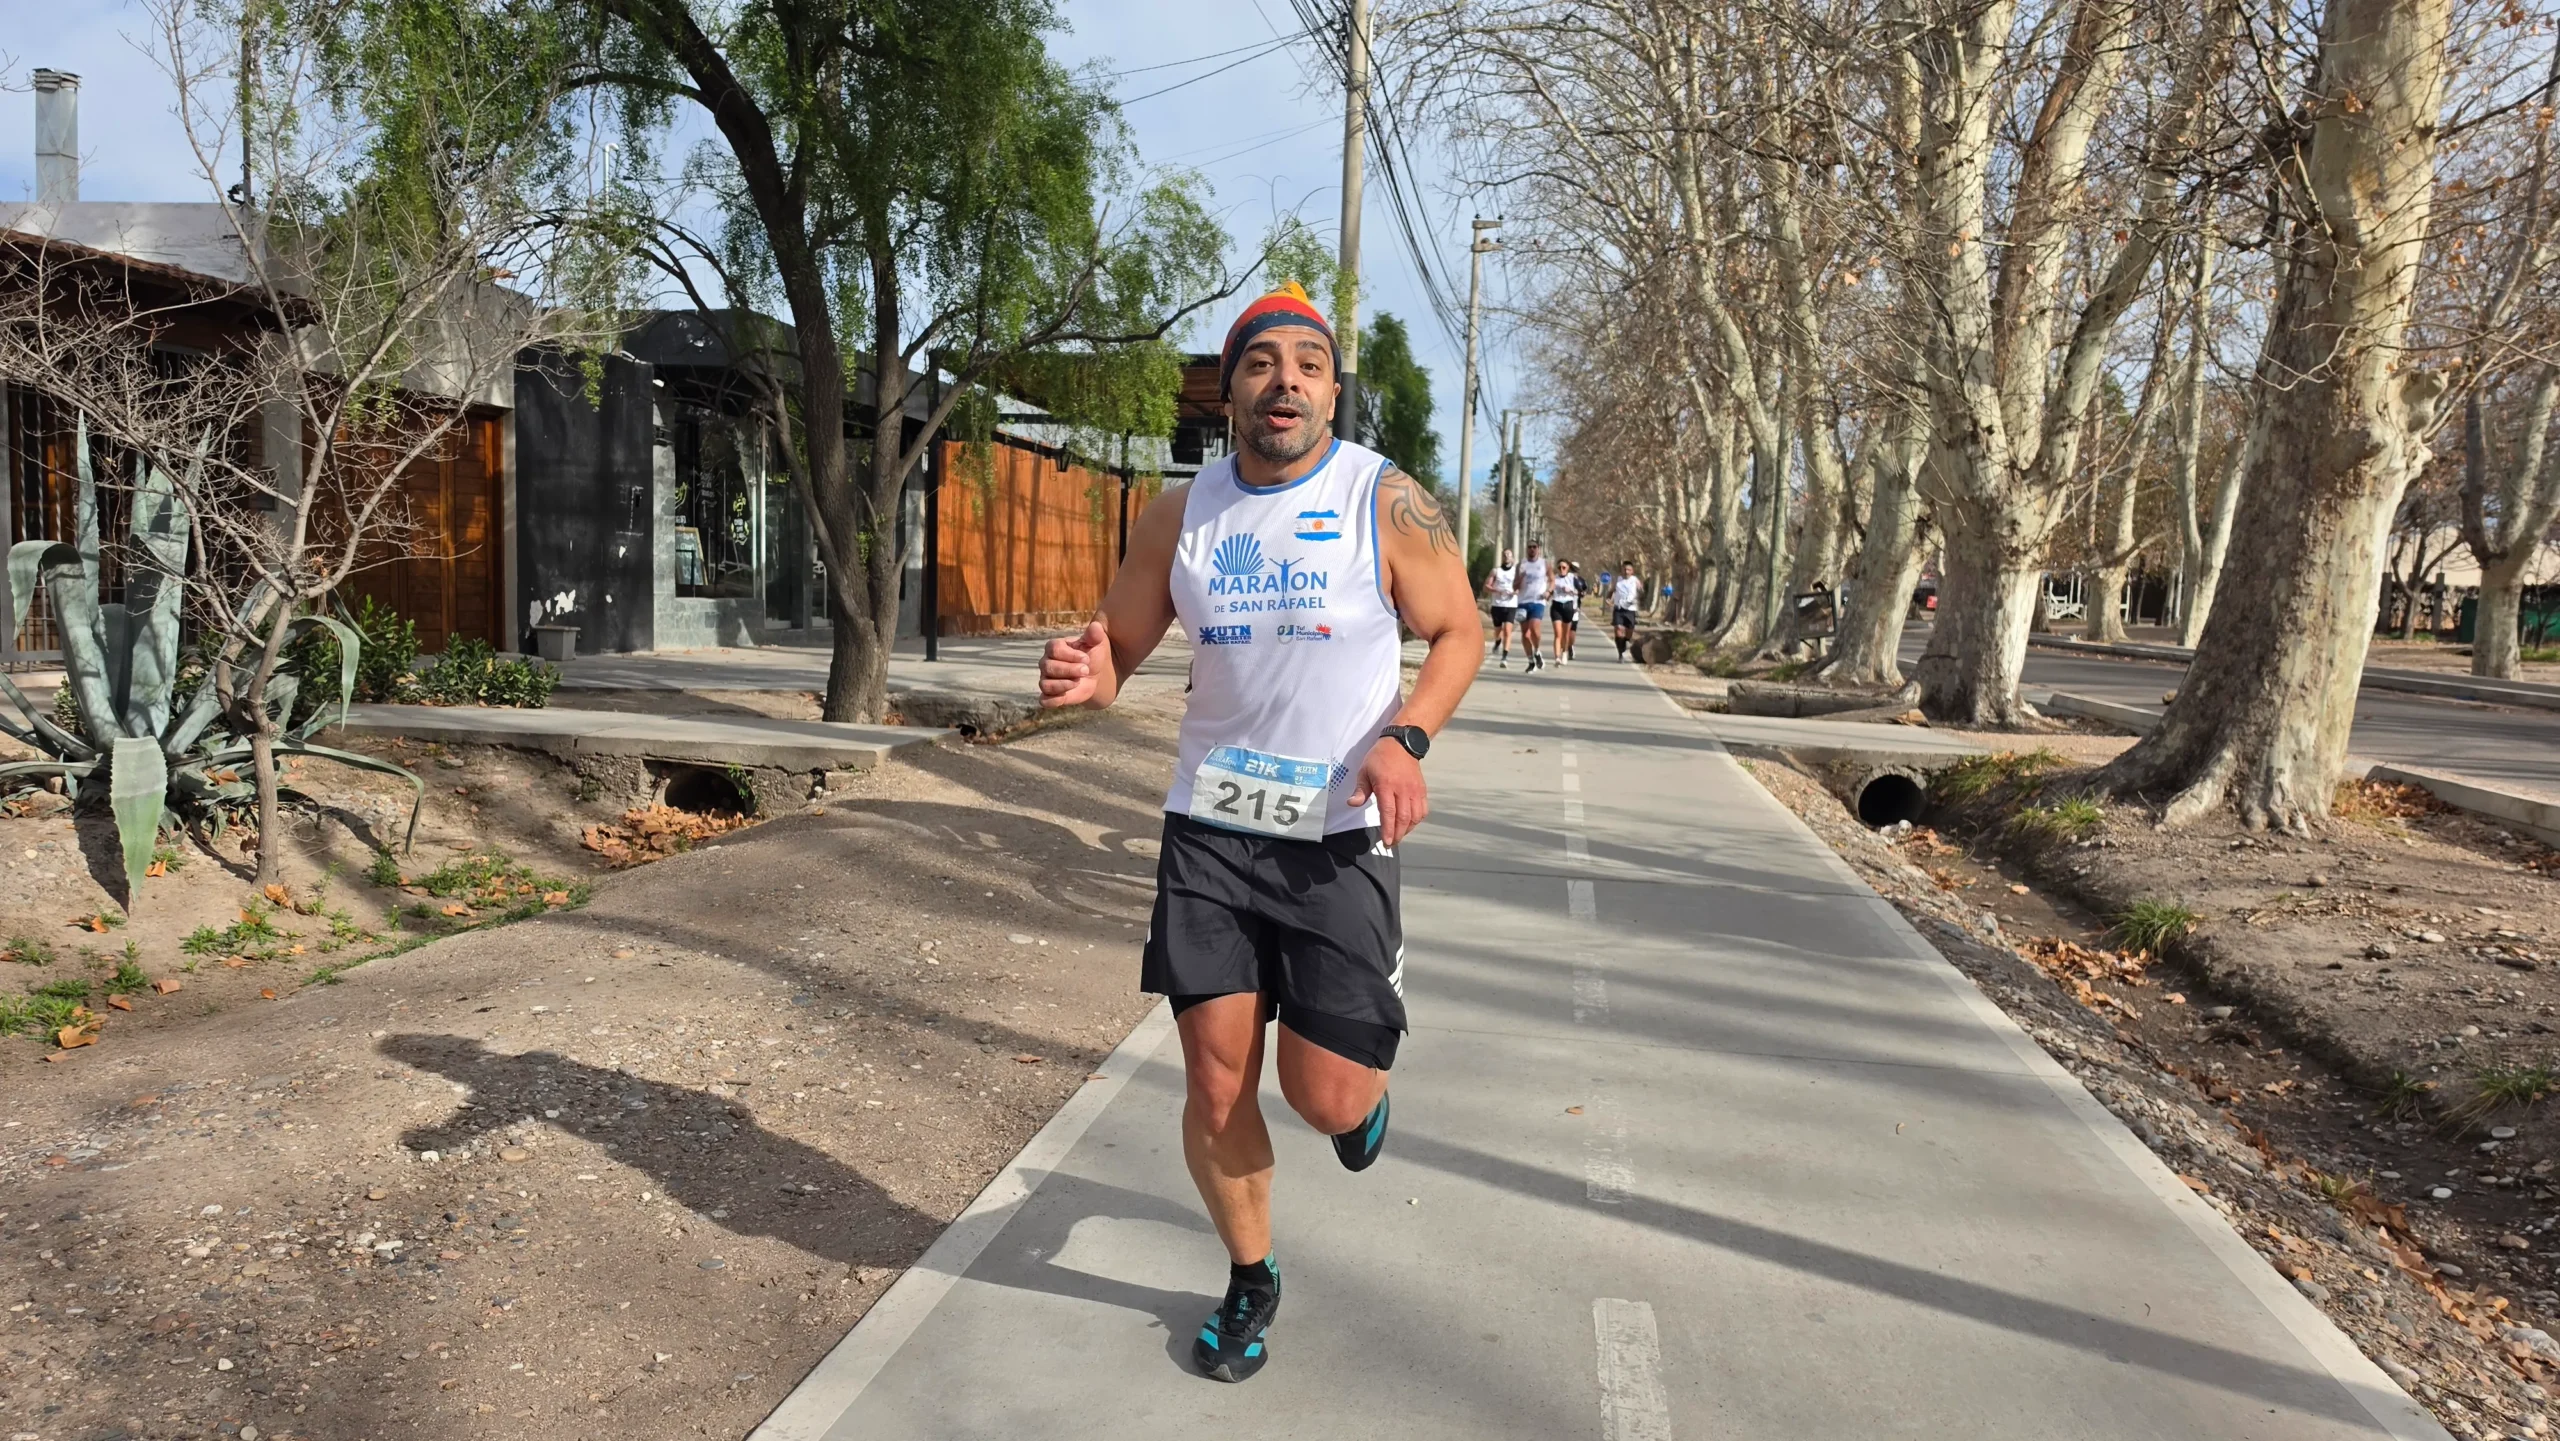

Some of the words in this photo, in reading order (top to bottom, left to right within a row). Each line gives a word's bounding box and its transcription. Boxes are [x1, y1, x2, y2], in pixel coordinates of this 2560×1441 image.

[1214, 604, 1225, 613] DE
[1229, 600, 1263, 613] SAN
[1267, 597, 1326, 611] RAFAEL
[1217, 625, 1251, 636] UTN
[1244, 758, 1281, 778] 21K
[1213, 780, 1301, 826] 215
